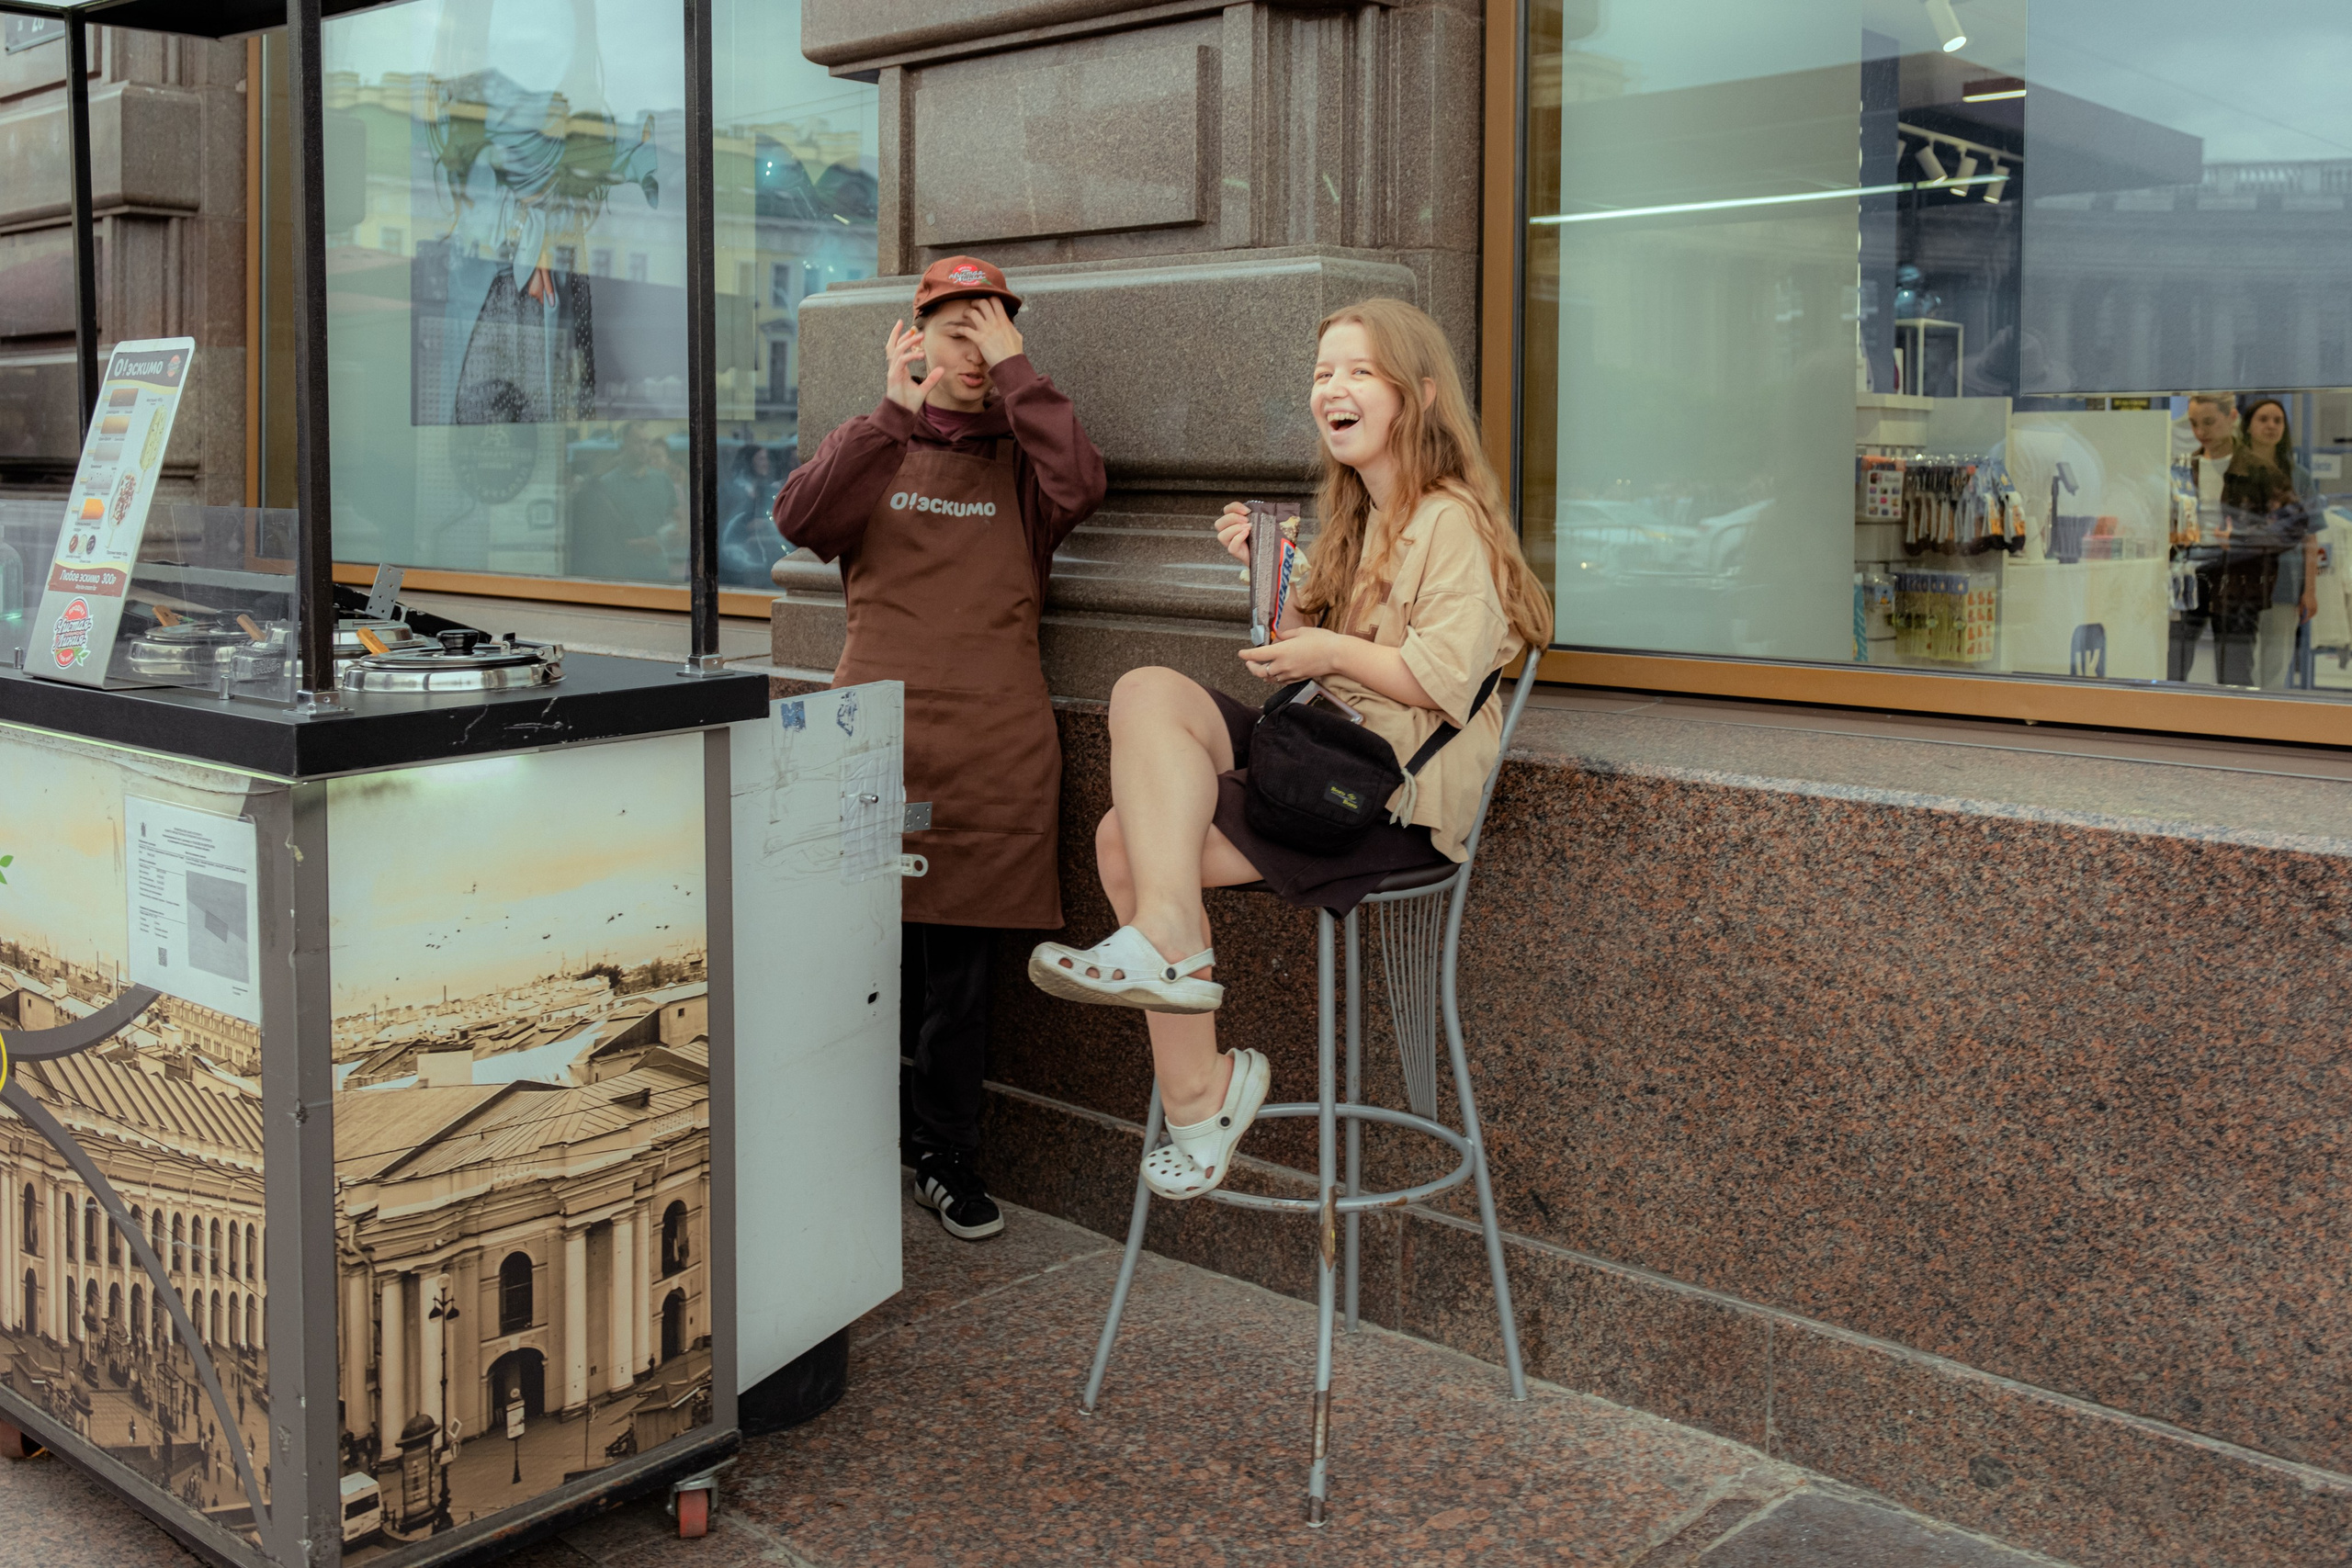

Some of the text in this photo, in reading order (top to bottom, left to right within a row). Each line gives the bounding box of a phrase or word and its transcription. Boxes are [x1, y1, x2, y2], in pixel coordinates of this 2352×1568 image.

[59, 569, 79, 581] Любое
[79, 573, 100, 584] эскимо
[55, 617, 92, 637] Чистая
